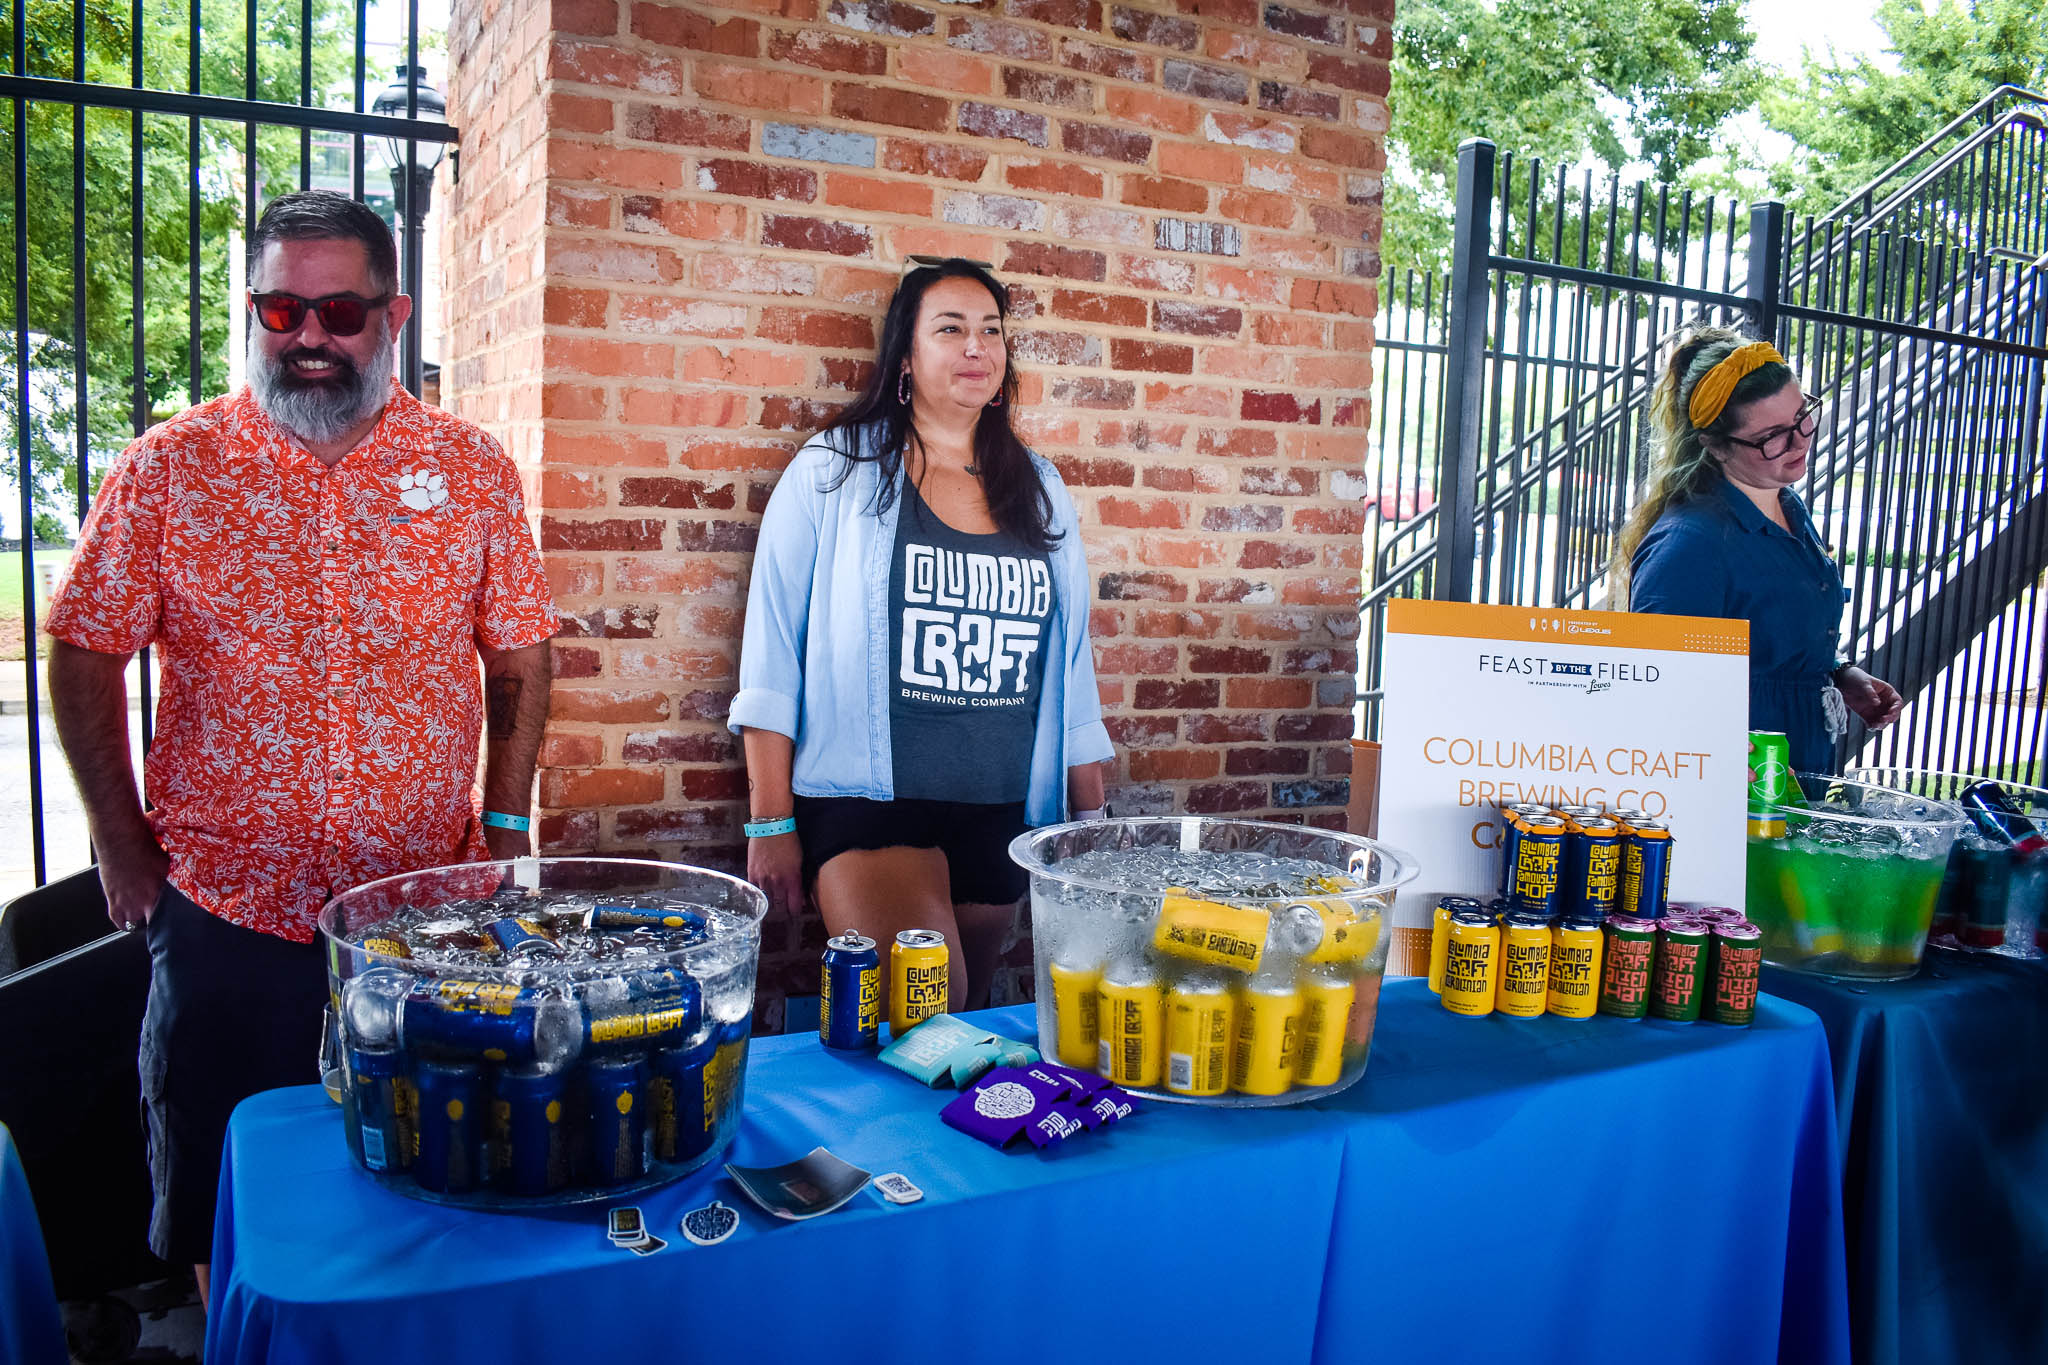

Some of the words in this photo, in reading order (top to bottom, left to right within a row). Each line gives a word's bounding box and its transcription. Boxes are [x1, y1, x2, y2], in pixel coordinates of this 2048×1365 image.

[904, 543, 1051, 618] COLUMBIA
[1579, 626, 1612, 635] LEXUS
[900, 607, 1040, 693] CRAFT
[1479, 655, 1547, 676] FEAST
[1555, 664, 1569, 673] BY
[1569, 665, 1587, 674] THE
[1598, 662, 1660, 682] FIELD
[901, 687, 967, 706] BREWING
[971, 696, 1025, 707] COMPANY
[1423, 736, 1598, 774] COLUMBIA
[1606, 748, 1711, 780] CRAFT
[1459, 779, 1608, 812] BREWING
[1616, 790, 1674, 819] CO.
[1519, 839, 1560, 858] COLUMBIA
[1518, 853, 1559, 873] CRAFT
[1517, 870, 1558, 885] FAMOUSLY
[1515, 881, 1557, 899] HOP
[1447, 939, 1490, 959] COLUMBIA
[1507, 943, 1548, 961] COLUMBIA
[1551, 943, 1592, 962] COLUMBIA
[906, 963, 948, 983] COLUMBIA
[1446, 956, 1488, 977] CRAFT
[1506, 961, 1547, 979] CRAFT
[1550, 961, 1591, 981] CRAFT
[906, 981, 948, 1004] CRAFT
